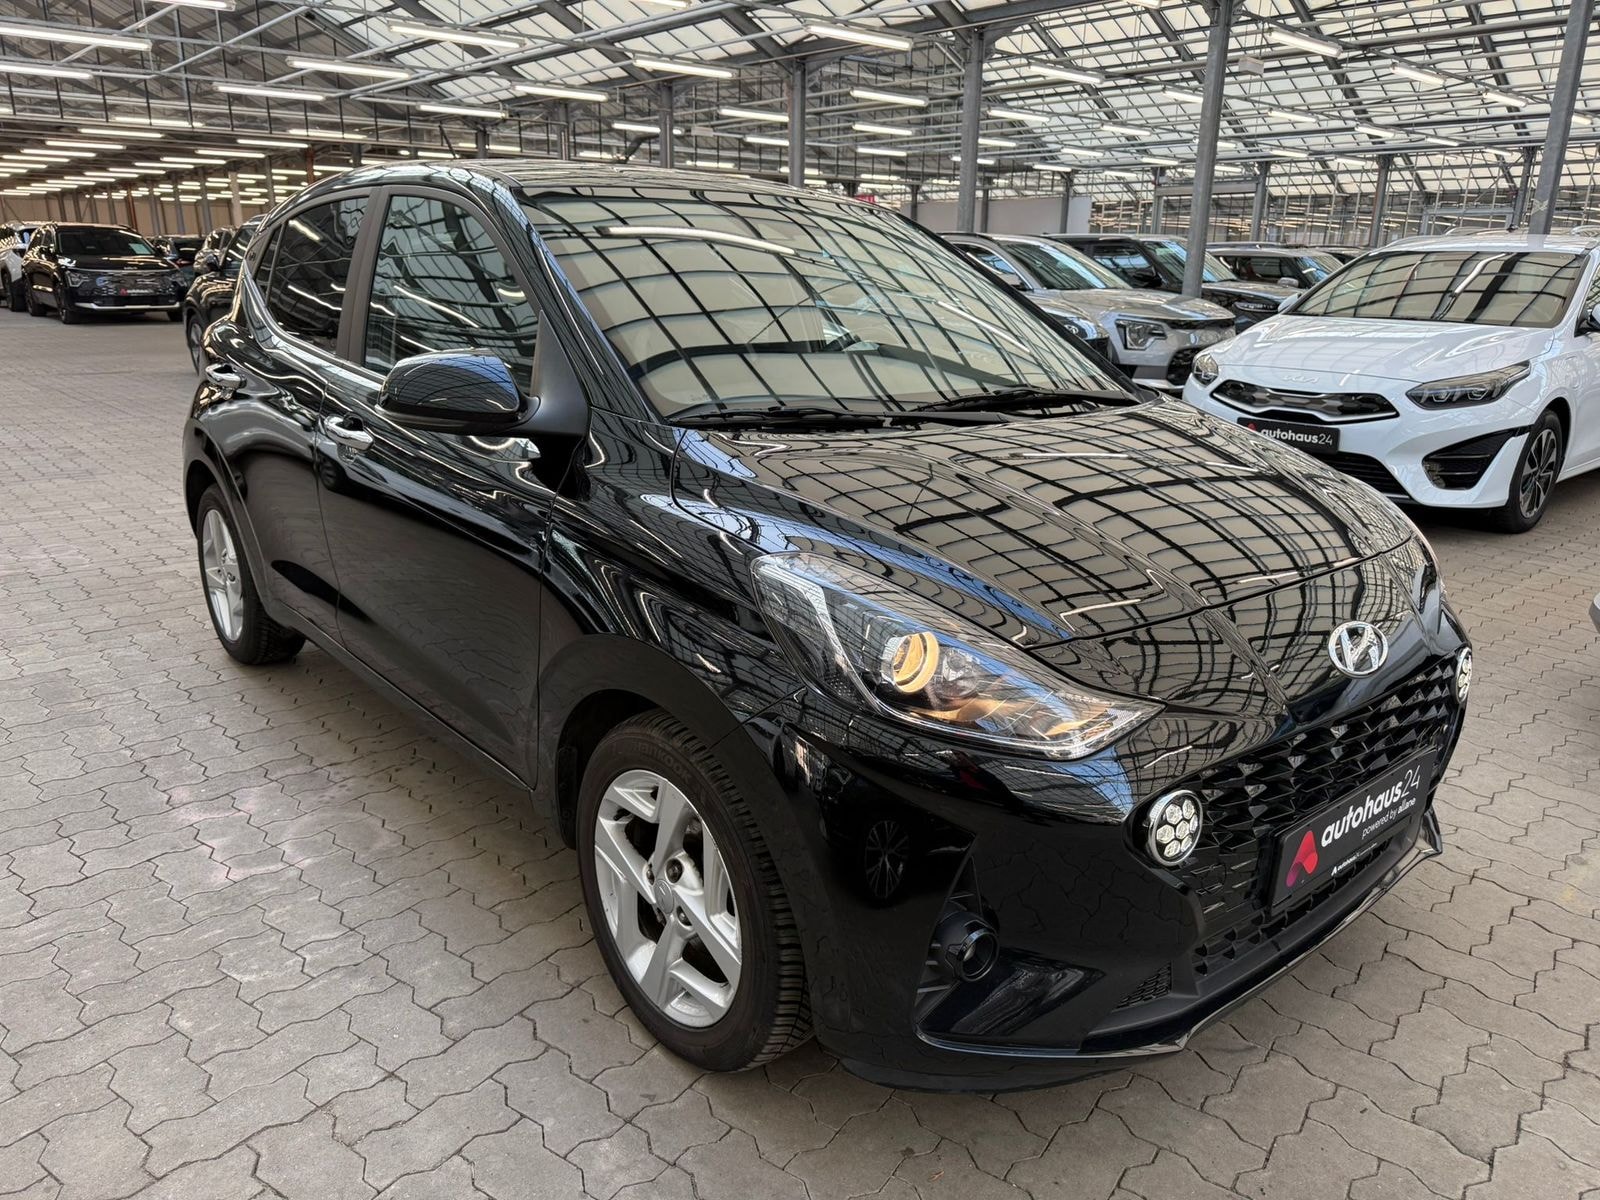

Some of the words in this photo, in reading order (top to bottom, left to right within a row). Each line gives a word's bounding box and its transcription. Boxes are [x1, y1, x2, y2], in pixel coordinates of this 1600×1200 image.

[1260, 428, 1333, 446] autohaus24
[1321, 765, 1420, 847] autohaus24
[1362, 810, 1389, 840] powered
[1389, 808, 1398, 820] by
[1398, 797, 1416, 814] allane
